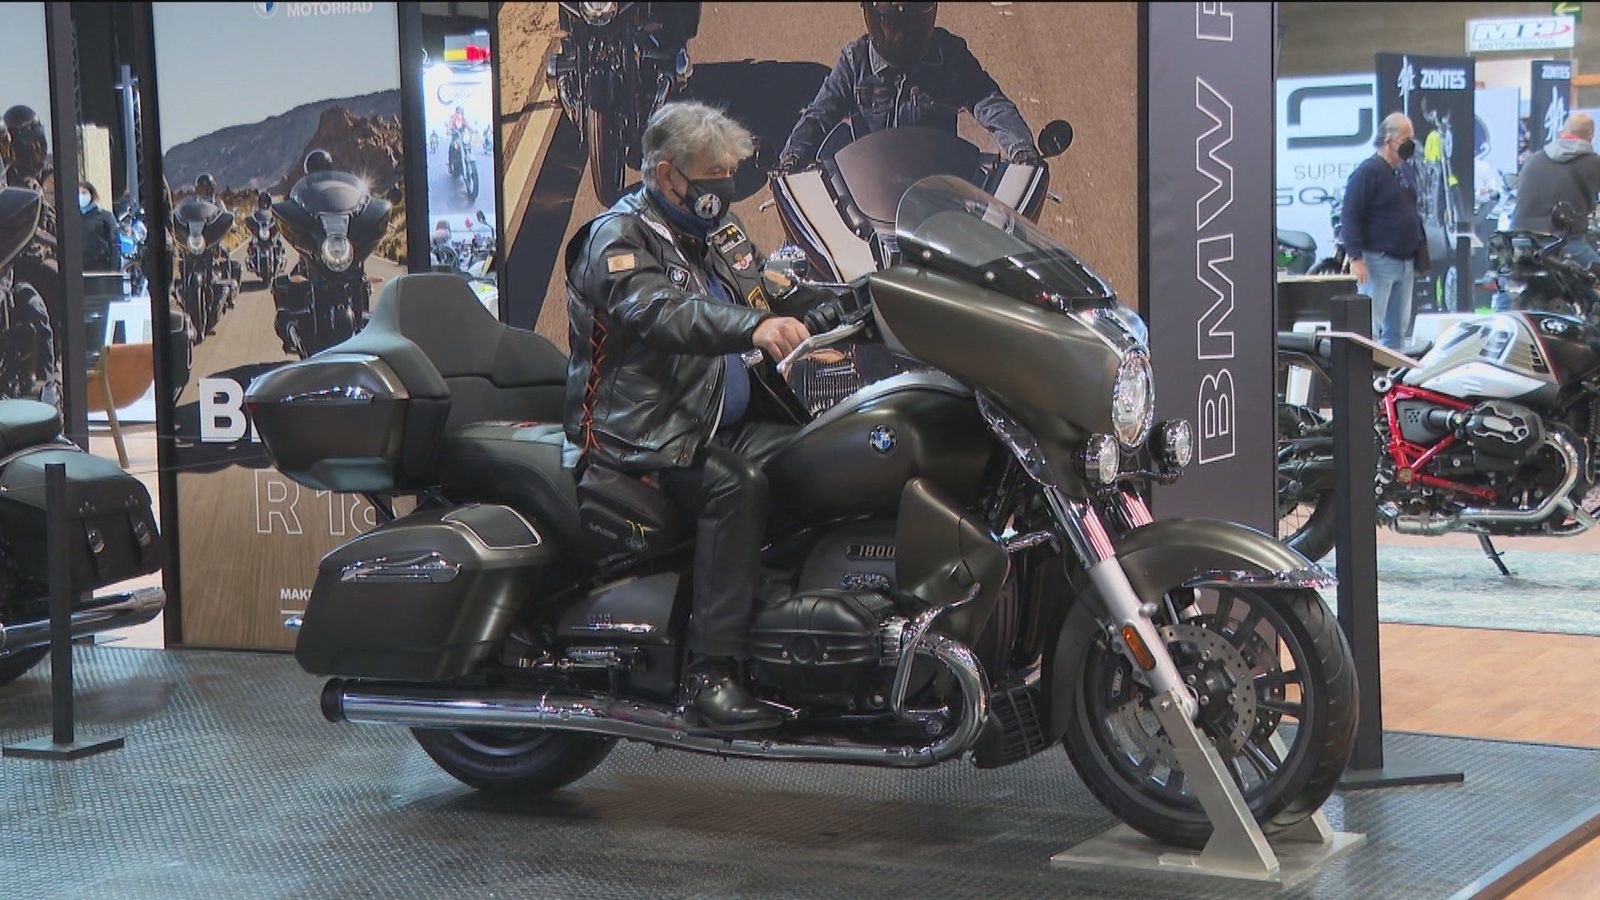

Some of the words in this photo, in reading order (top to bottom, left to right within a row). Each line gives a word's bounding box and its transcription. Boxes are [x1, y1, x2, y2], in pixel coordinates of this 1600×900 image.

[287, 2, 373, 17] MOTORRAD
[1420, 69, 1466, 90] ZONTES
[1541, 65, 1570, 79] ZONTES
[1196, 76, 1236, 465] BMW
[254, 468, 303, 536] R
[859, 545, 896, 557] 1800
